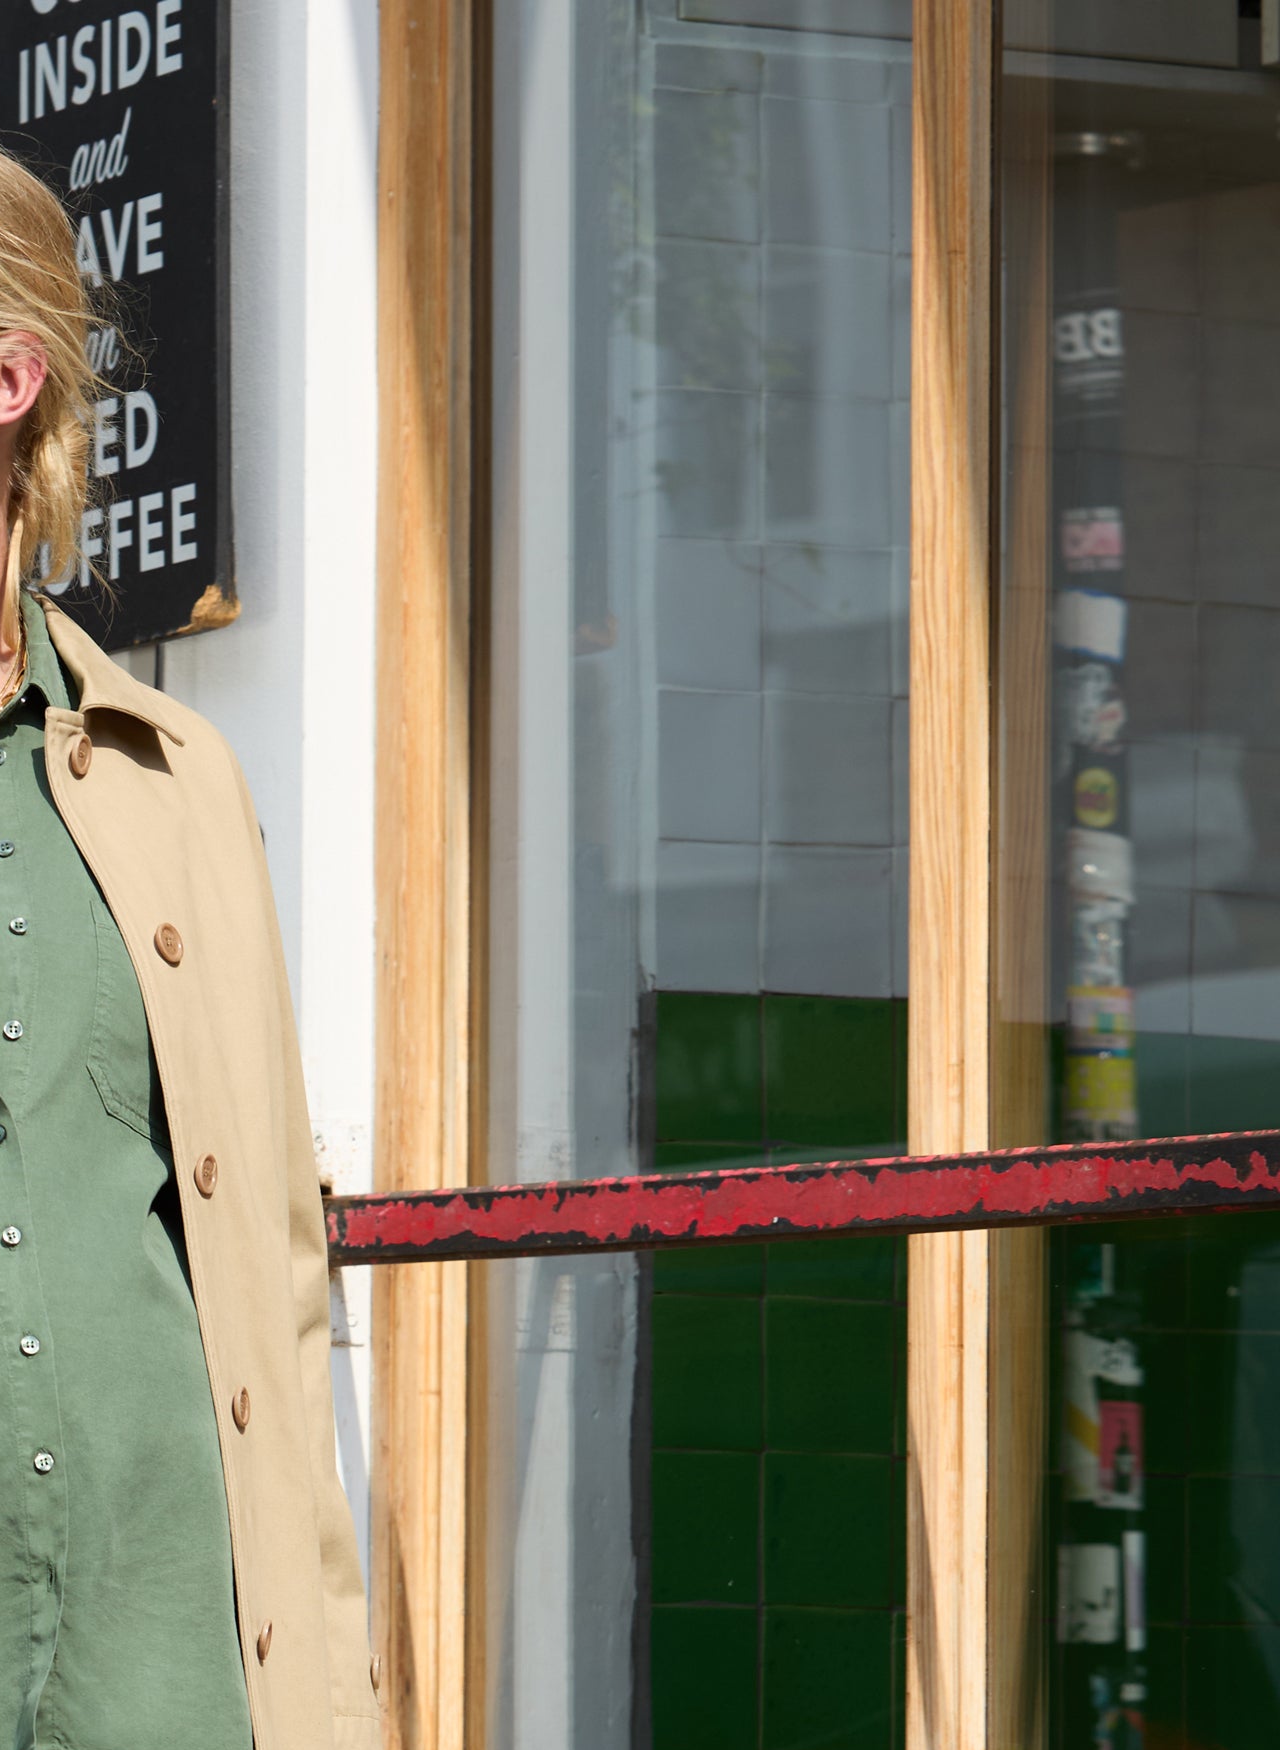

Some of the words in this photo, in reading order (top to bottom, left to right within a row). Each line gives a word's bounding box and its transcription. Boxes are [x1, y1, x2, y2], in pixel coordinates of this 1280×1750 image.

[19, 0, 183, 122] INSIDE
[70, 106, 131, 191] and
[75, 193, 164, 289] AVE
[27, 482, 198, 596] OFFEE
